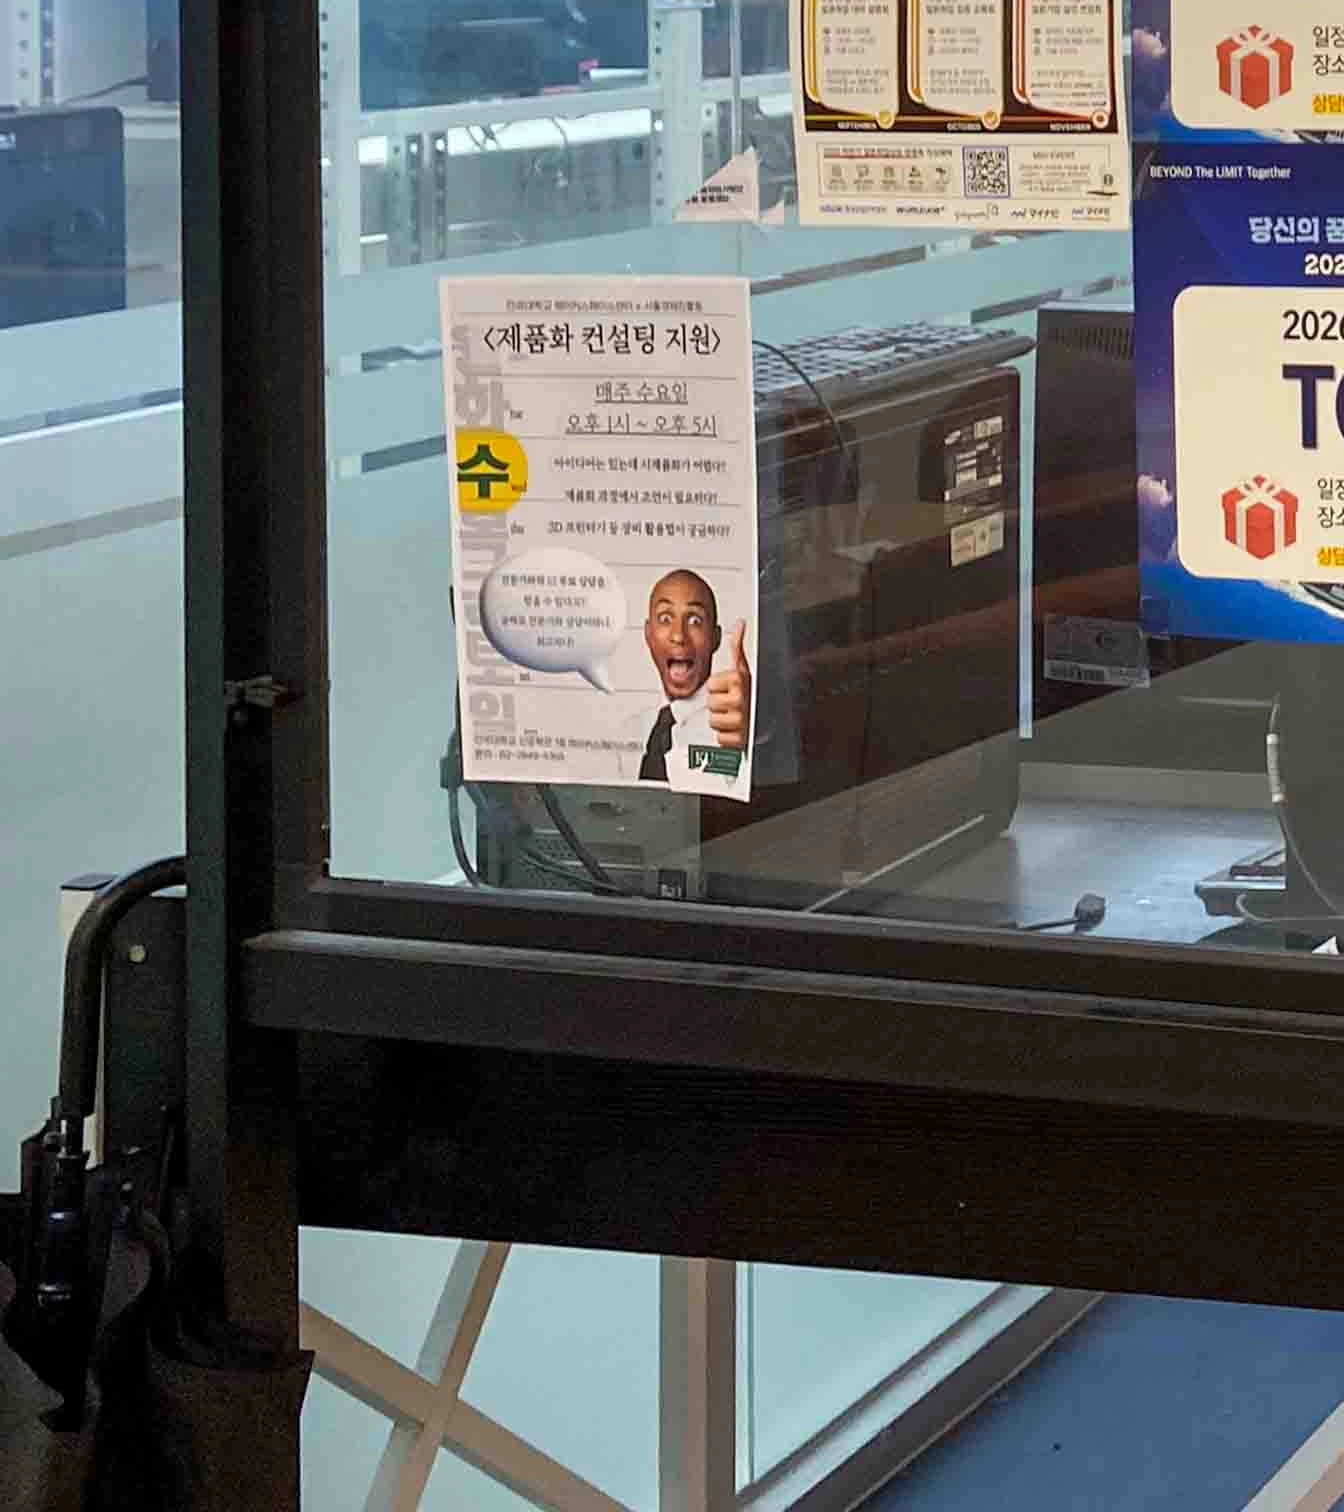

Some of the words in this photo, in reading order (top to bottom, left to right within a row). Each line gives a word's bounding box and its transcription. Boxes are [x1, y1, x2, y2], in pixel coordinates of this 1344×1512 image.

[582, 323, 654, 354] 컨설팅
[596, 383, 631, 400] 매주
[637, 382, 688, 401] 수요일
